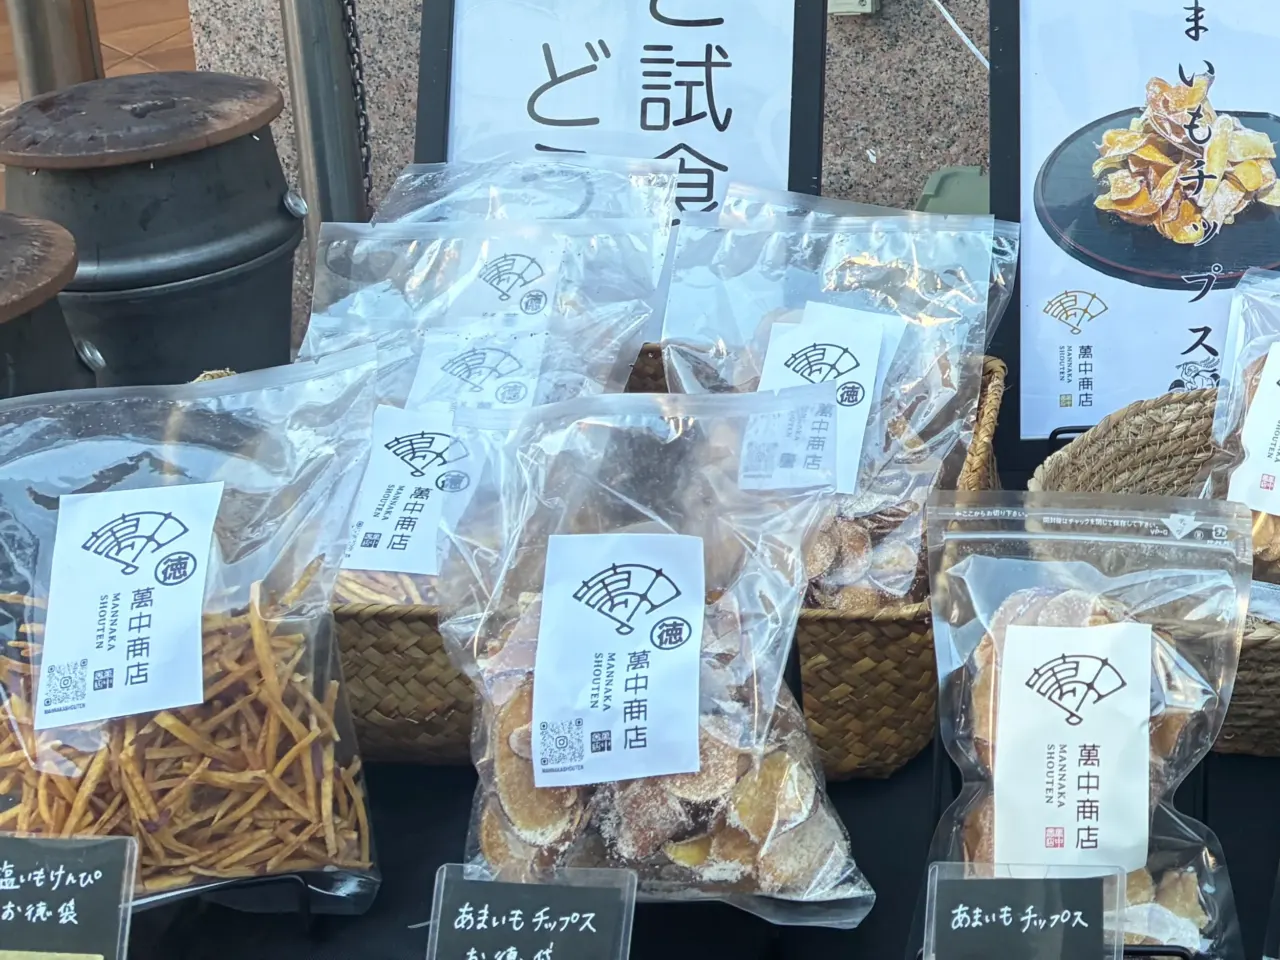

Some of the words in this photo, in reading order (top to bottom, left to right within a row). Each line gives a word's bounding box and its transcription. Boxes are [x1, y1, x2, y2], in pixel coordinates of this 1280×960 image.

[1078, 345, 1093, 407] 萬中商店
[373, 484, 396, 518] SHOUTEN
[381, 485, 405, 521] MANNAKA
[386, 486, 433, 552] 萬中商店
[159, 553, 193, 584] 徳
[95, 594, 109, 650] SHOUTEN
[107, 592, 121, 652] MANNAKA
[124, 587, 155, 686] 萬中商店
[654, 619, 687, 648] 徳
[590, 652, 604, 709] SHOUTEN
[602, 652, 616, 712] MANNAKA
[623, 649, 651, 750] 萬中商店
[1045, 743, 1056, 804] SHOUTEN
[1057, 743, 1068, 808] MANNAKA
[1076, 744, 1101, 849] 萬中商店
